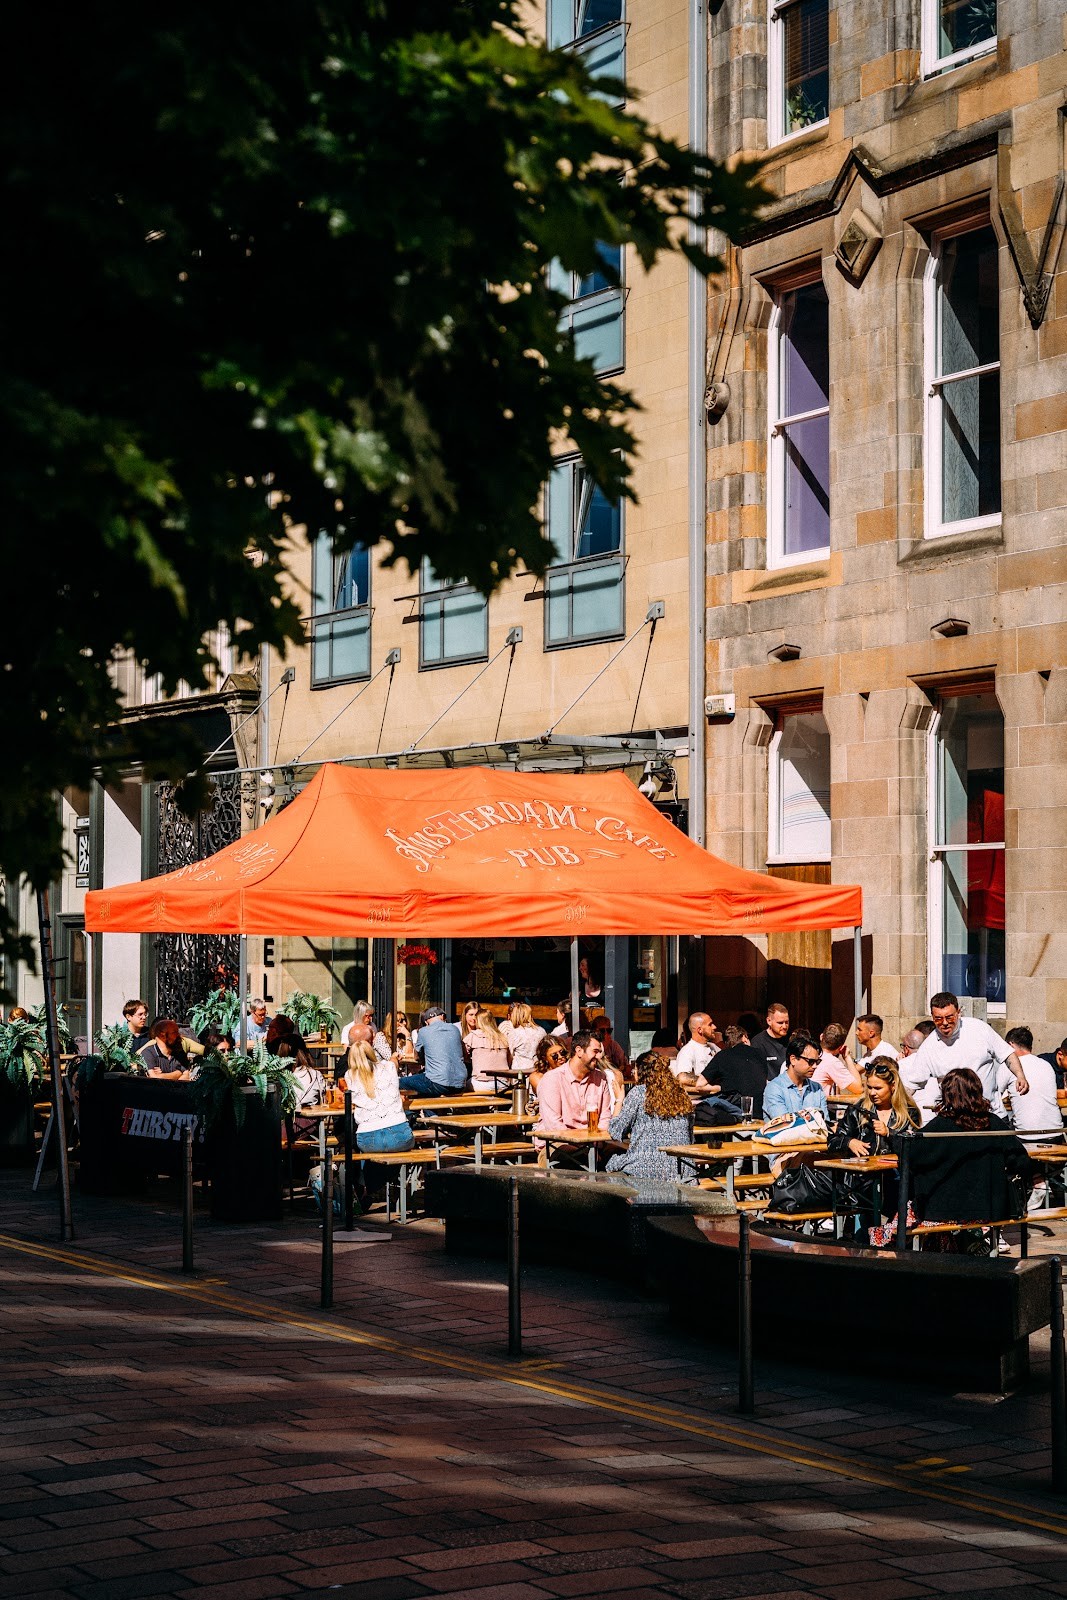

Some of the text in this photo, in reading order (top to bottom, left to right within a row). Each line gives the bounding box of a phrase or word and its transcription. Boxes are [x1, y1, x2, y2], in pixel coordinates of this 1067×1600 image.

[384, 800, 677, 873] AMSTERDAM CAFE
[507, 845, 580, 868] PUB
